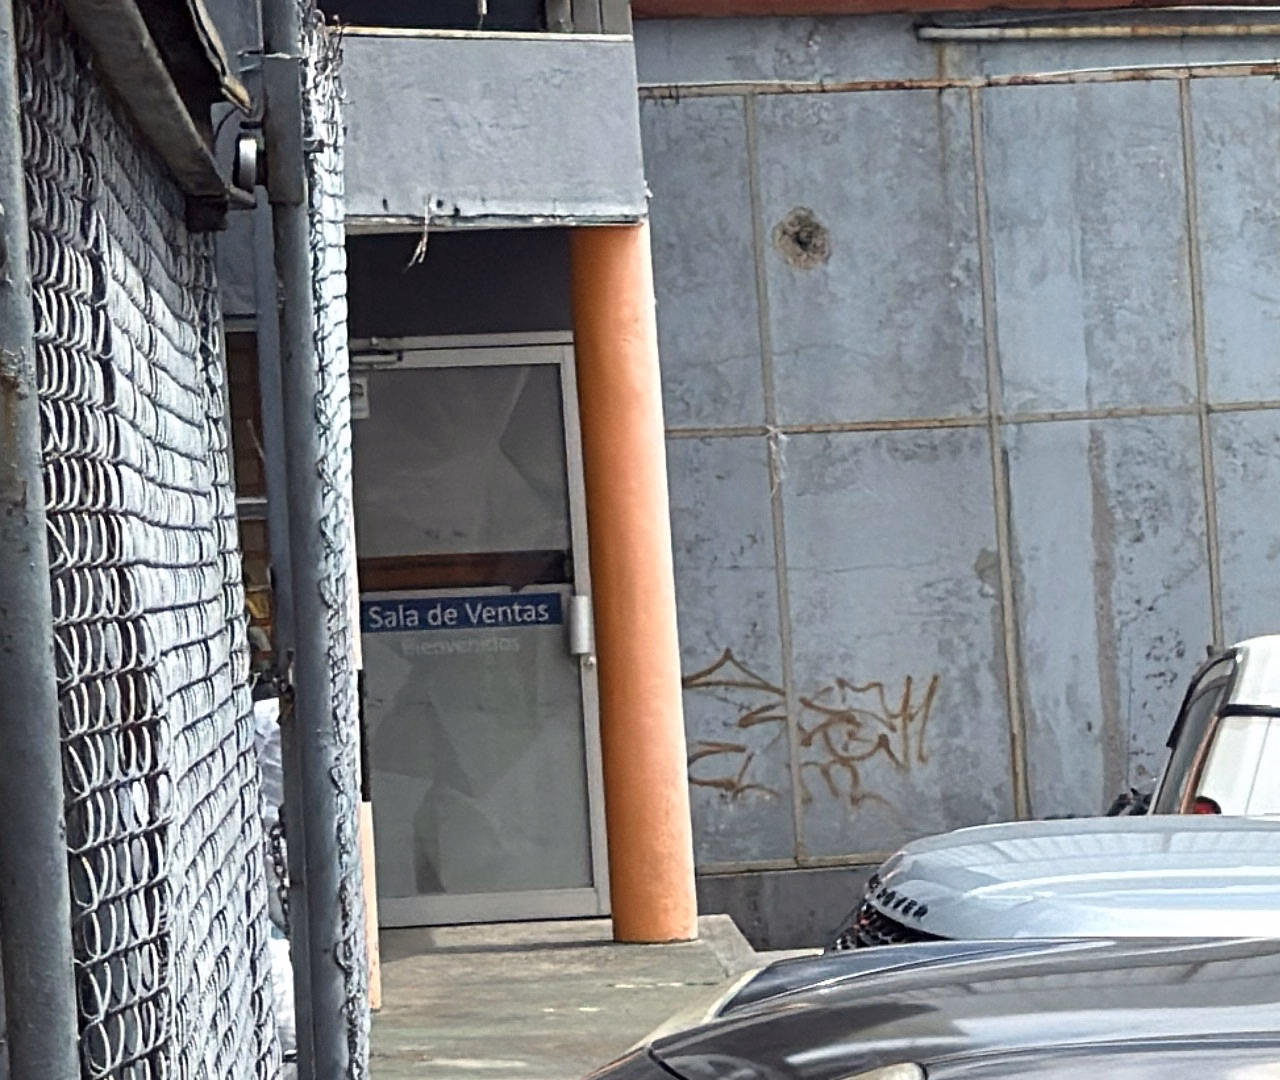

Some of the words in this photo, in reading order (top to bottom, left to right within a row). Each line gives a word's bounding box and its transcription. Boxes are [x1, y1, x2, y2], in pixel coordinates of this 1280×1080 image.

[369, 604, 419, 629] Sala
[427, 603, 458, 626] de
[465, 602, 550, 624] Ventas
